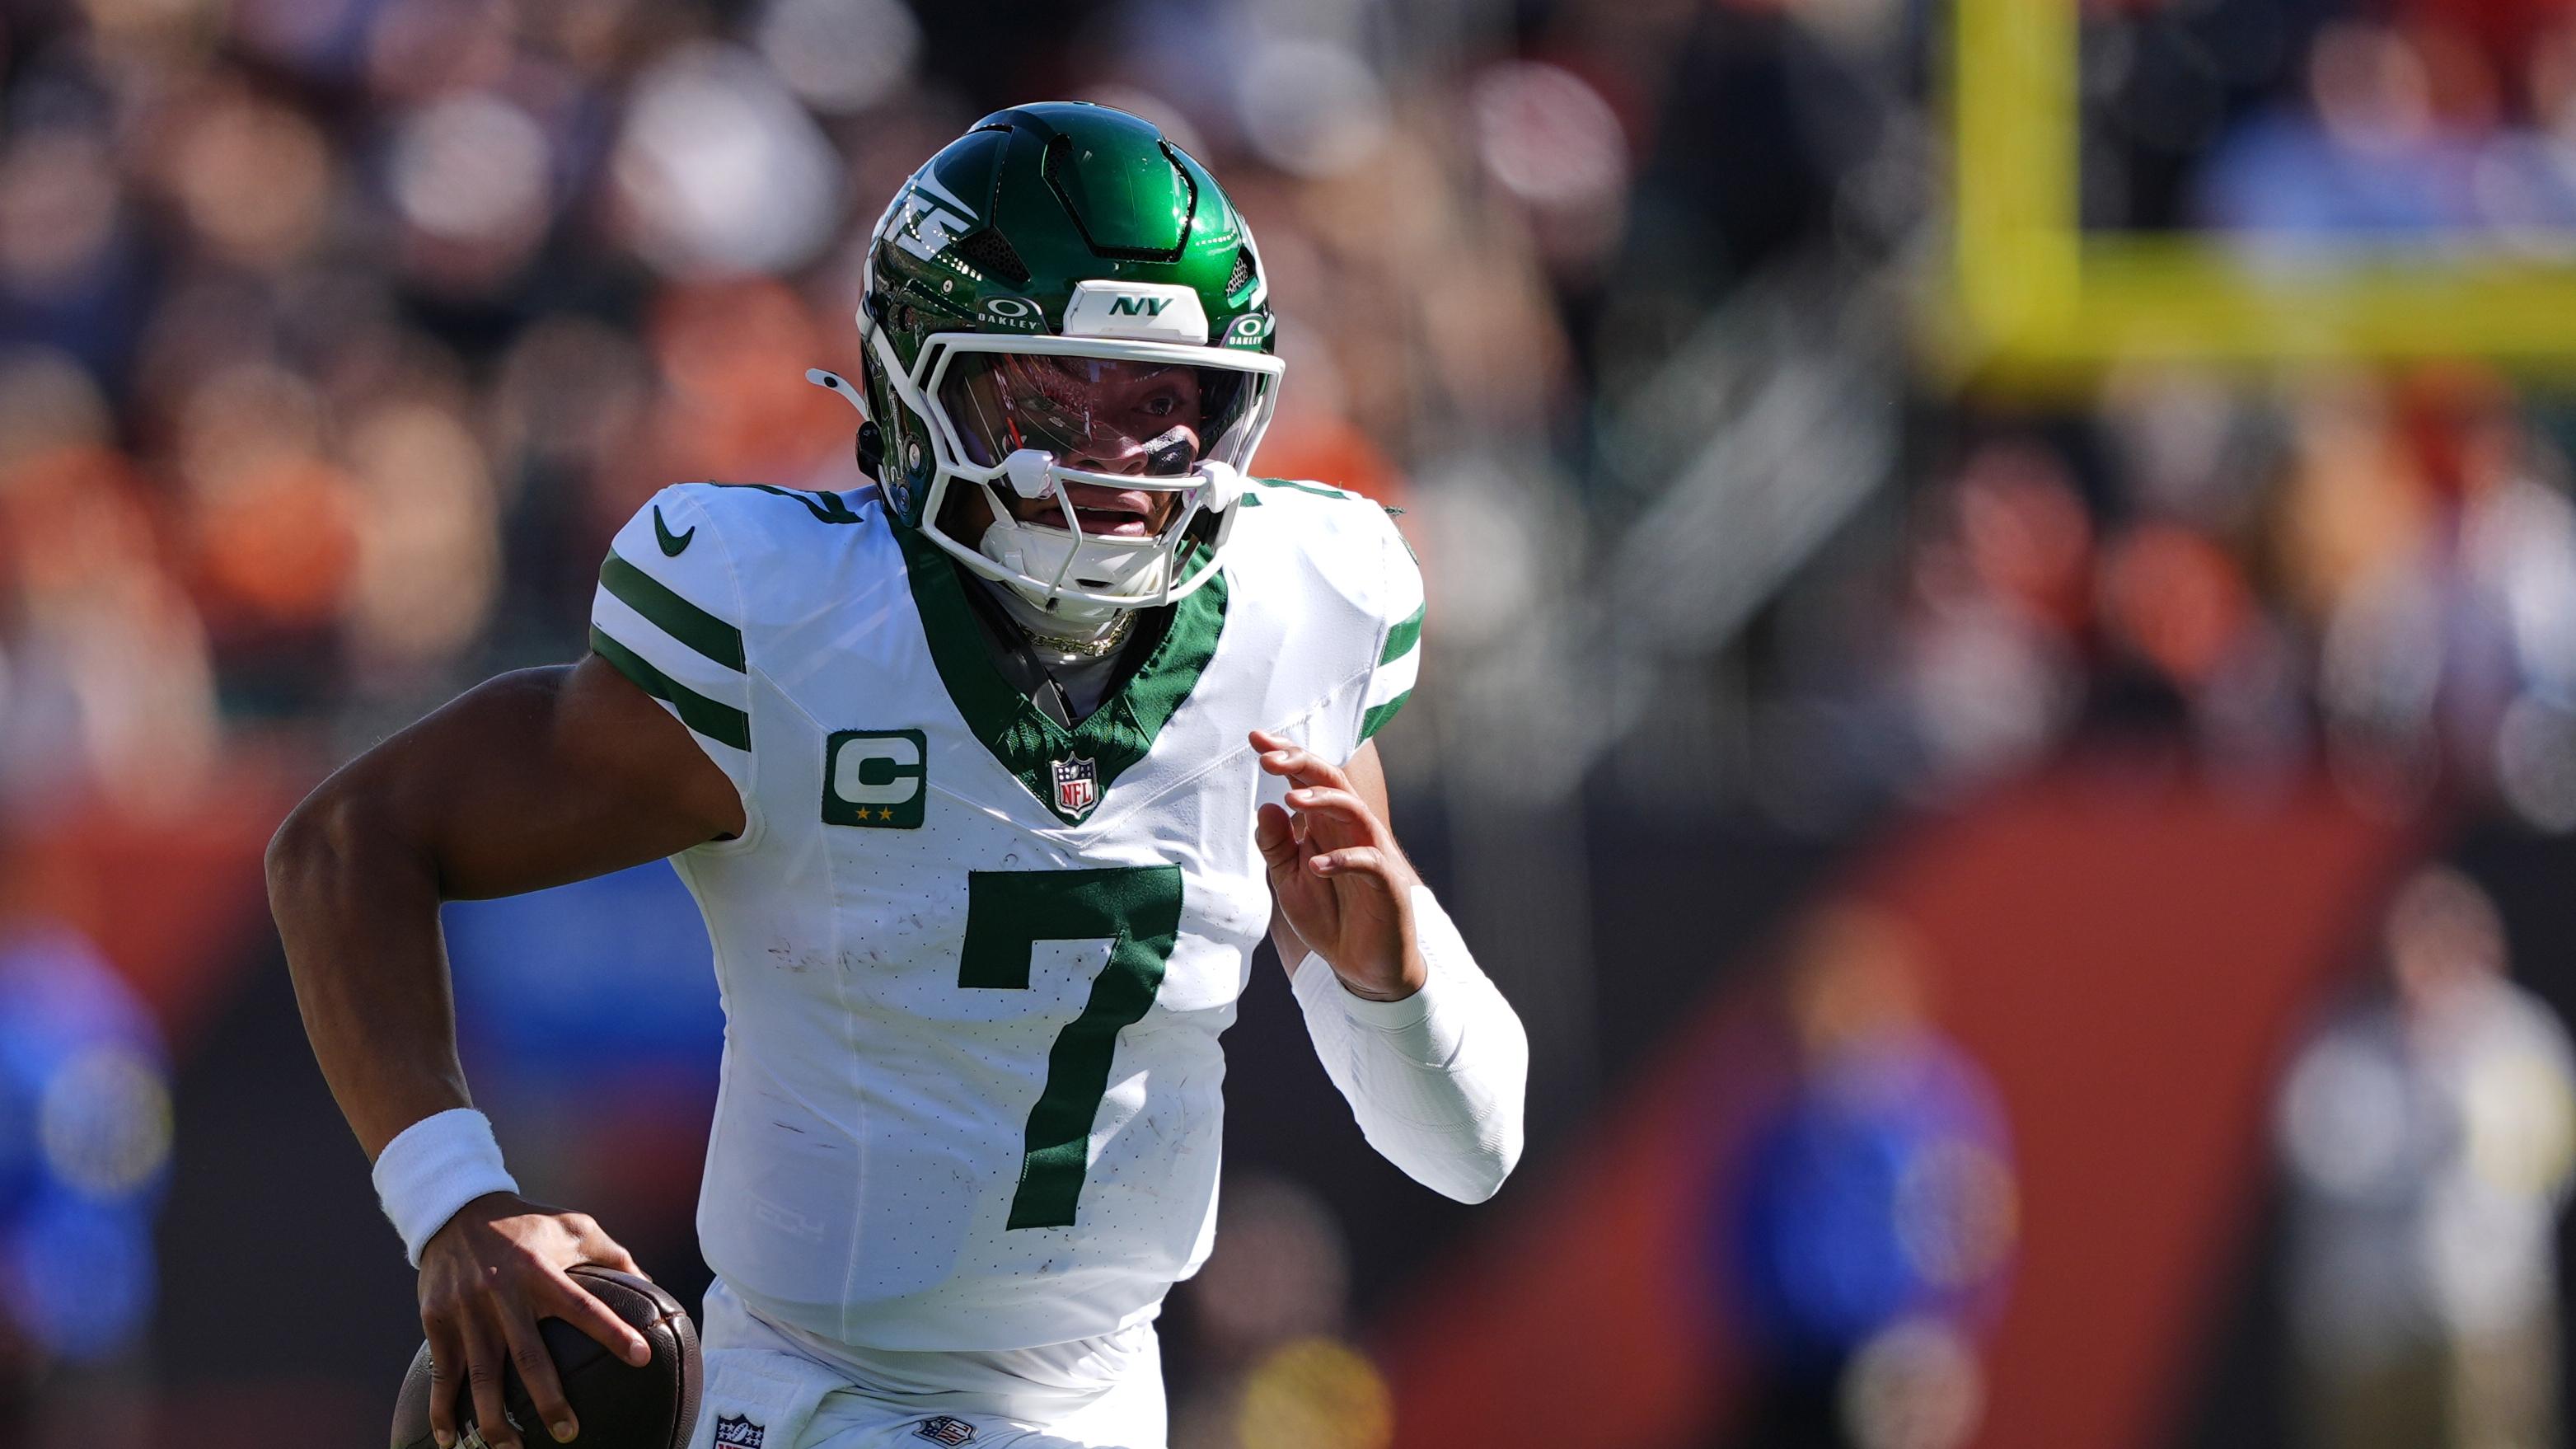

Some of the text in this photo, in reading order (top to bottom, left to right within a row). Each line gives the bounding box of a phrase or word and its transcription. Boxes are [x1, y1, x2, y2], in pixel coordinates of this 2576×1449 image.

[1108, 297, 1174, 316] NY
[978, 313, 1037, 330] OAKLEY
[834, 737, 920, 804] C
[1061, 782, 1092, 807] NFL
[958, 865, 1184, 1231] 7
[937, 1423, 970, 1443] NFL
